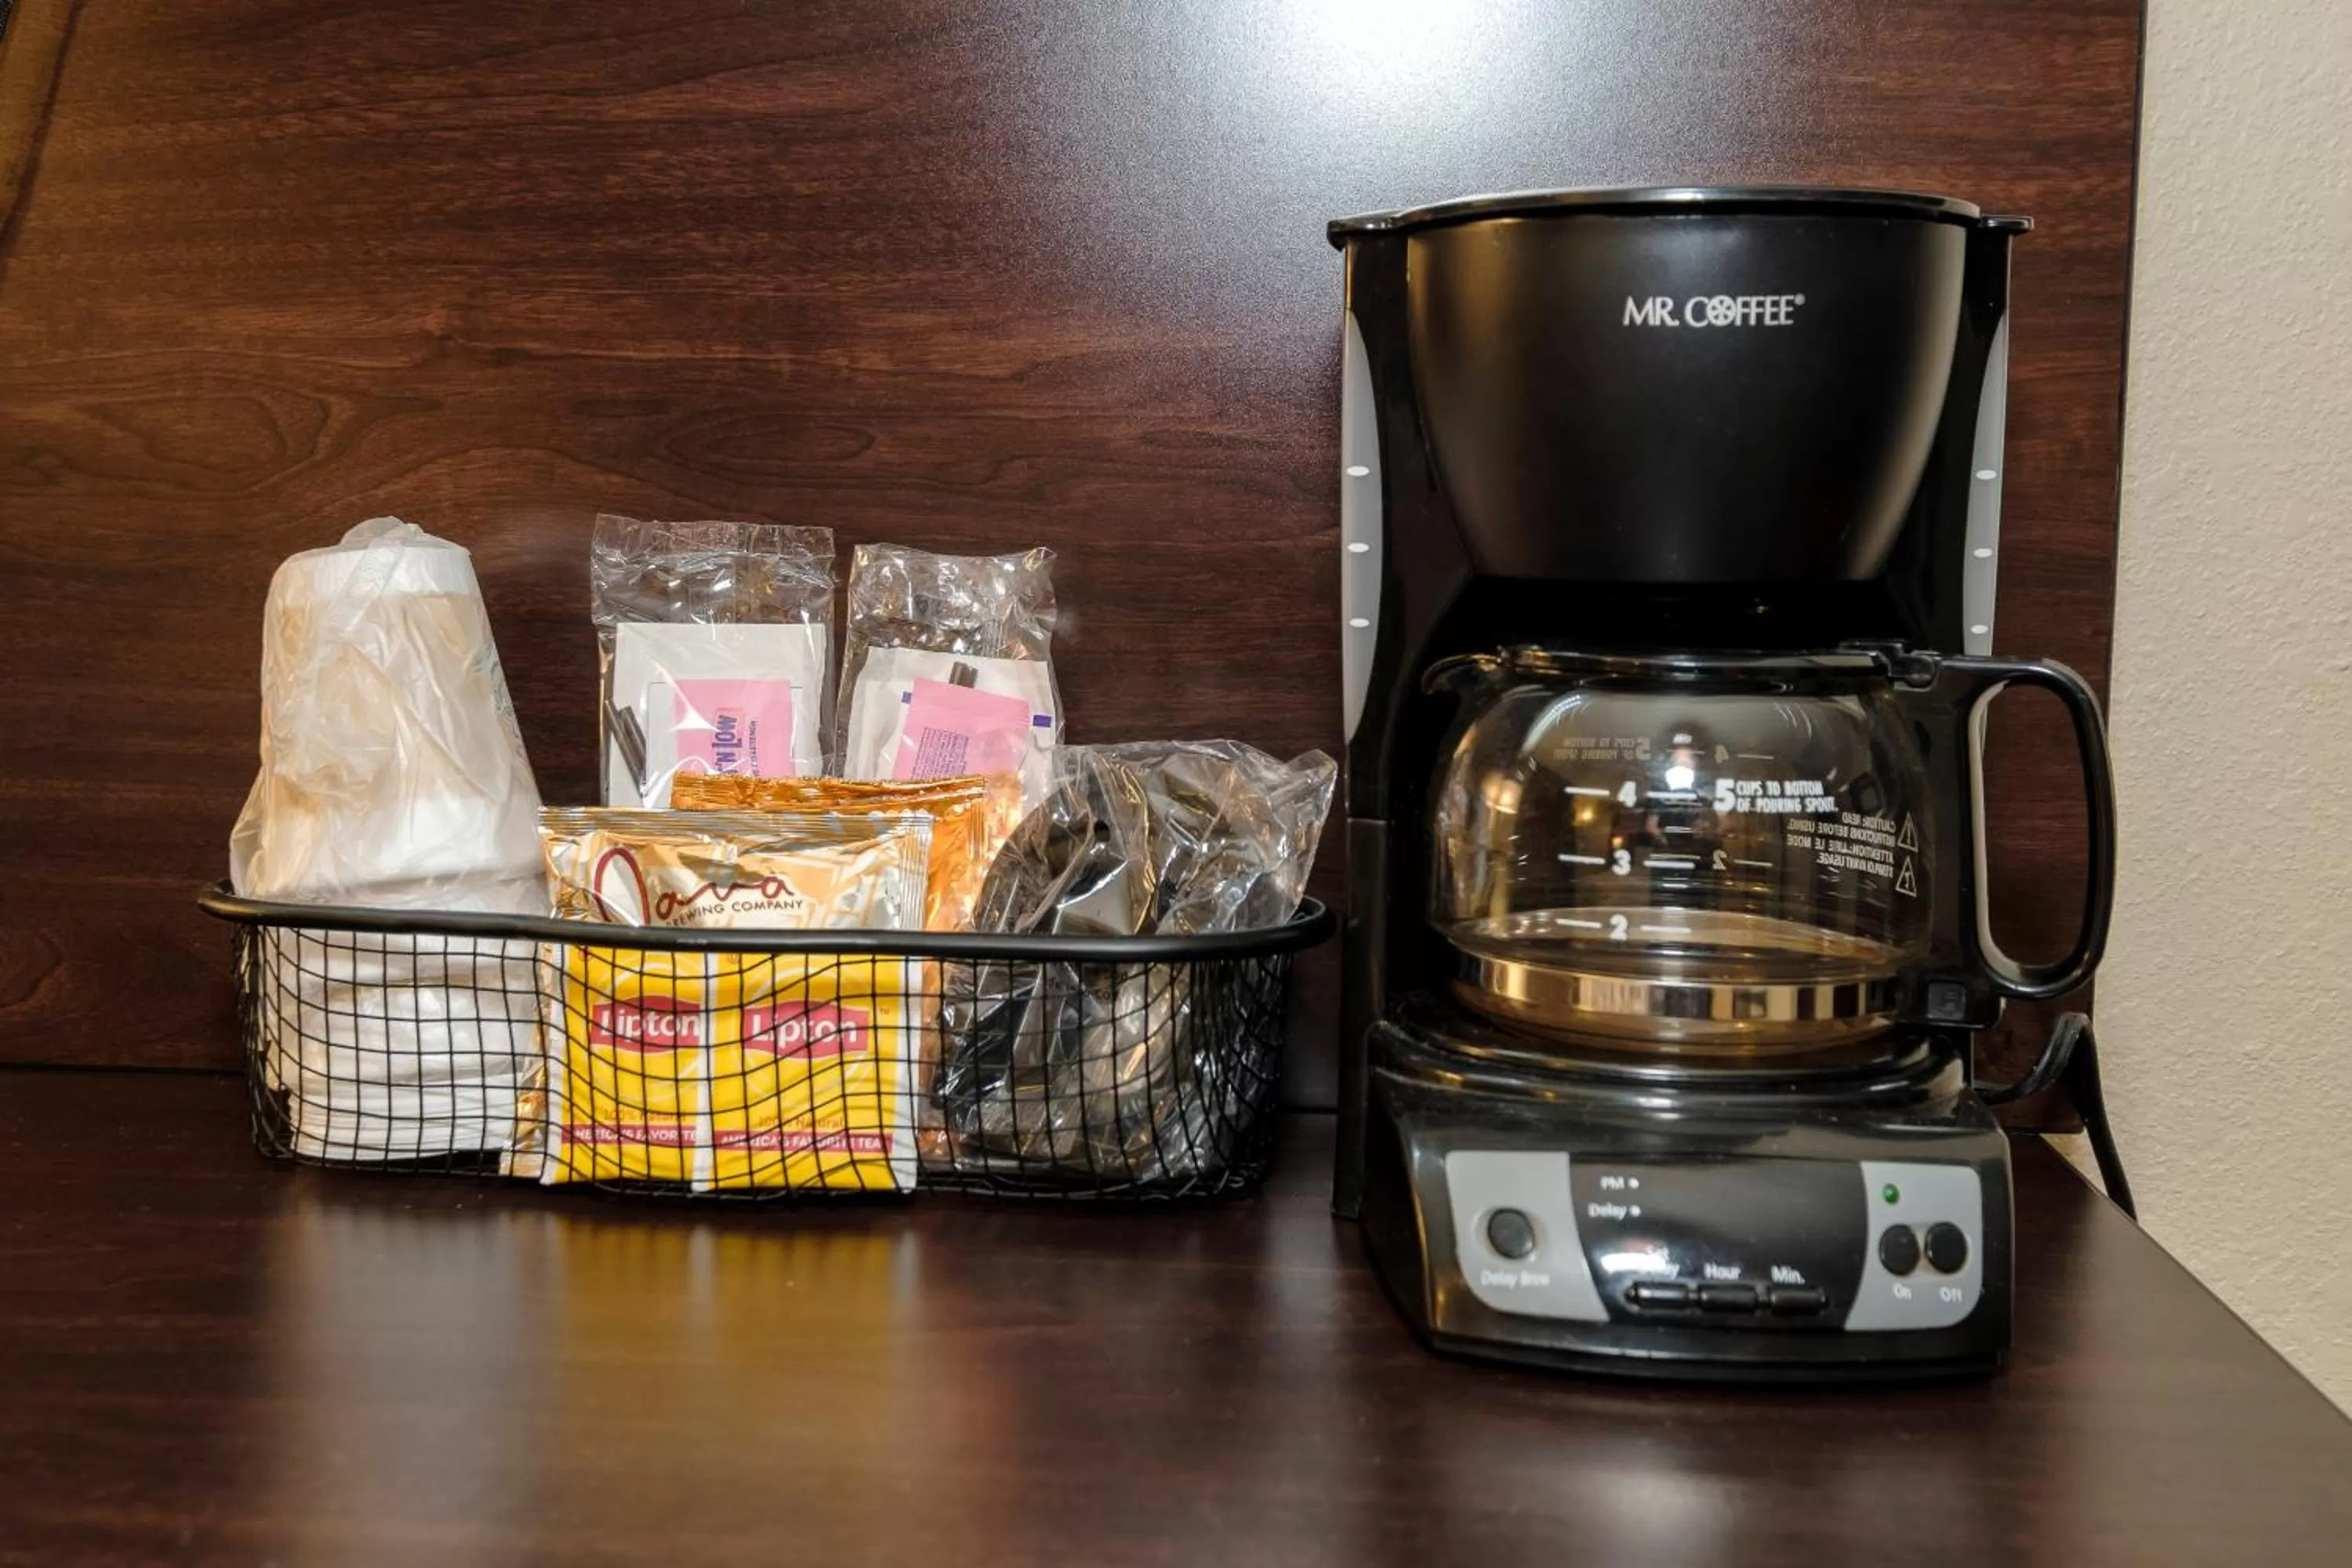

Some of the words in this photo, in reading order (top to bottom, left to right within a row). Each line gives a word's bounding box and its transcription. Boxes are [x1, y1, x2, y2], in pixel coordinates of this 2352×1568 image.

[1622, 295, 1680, 327] MR.
[1617, 781, 1637, 808] 4
[1714, 779, 1736, 813] 5
[1611, 849, 1632, 876] 3
[668, 903, 725, 927] REWING
[731, 899, 804, 913] COMPANY
[1609, 913, 1628, 941] 2
[601, 1008, 702, 1042] Lipton
[753, 1014, 858, 1047] Lipton
[1601, 1178, 1625, 1189] PM
[1588, 1203, 1627, 1220] Delay
[1704, 1262, 1742, 1279] Hour
[1770, 1265, 1806, 1285] Min.
